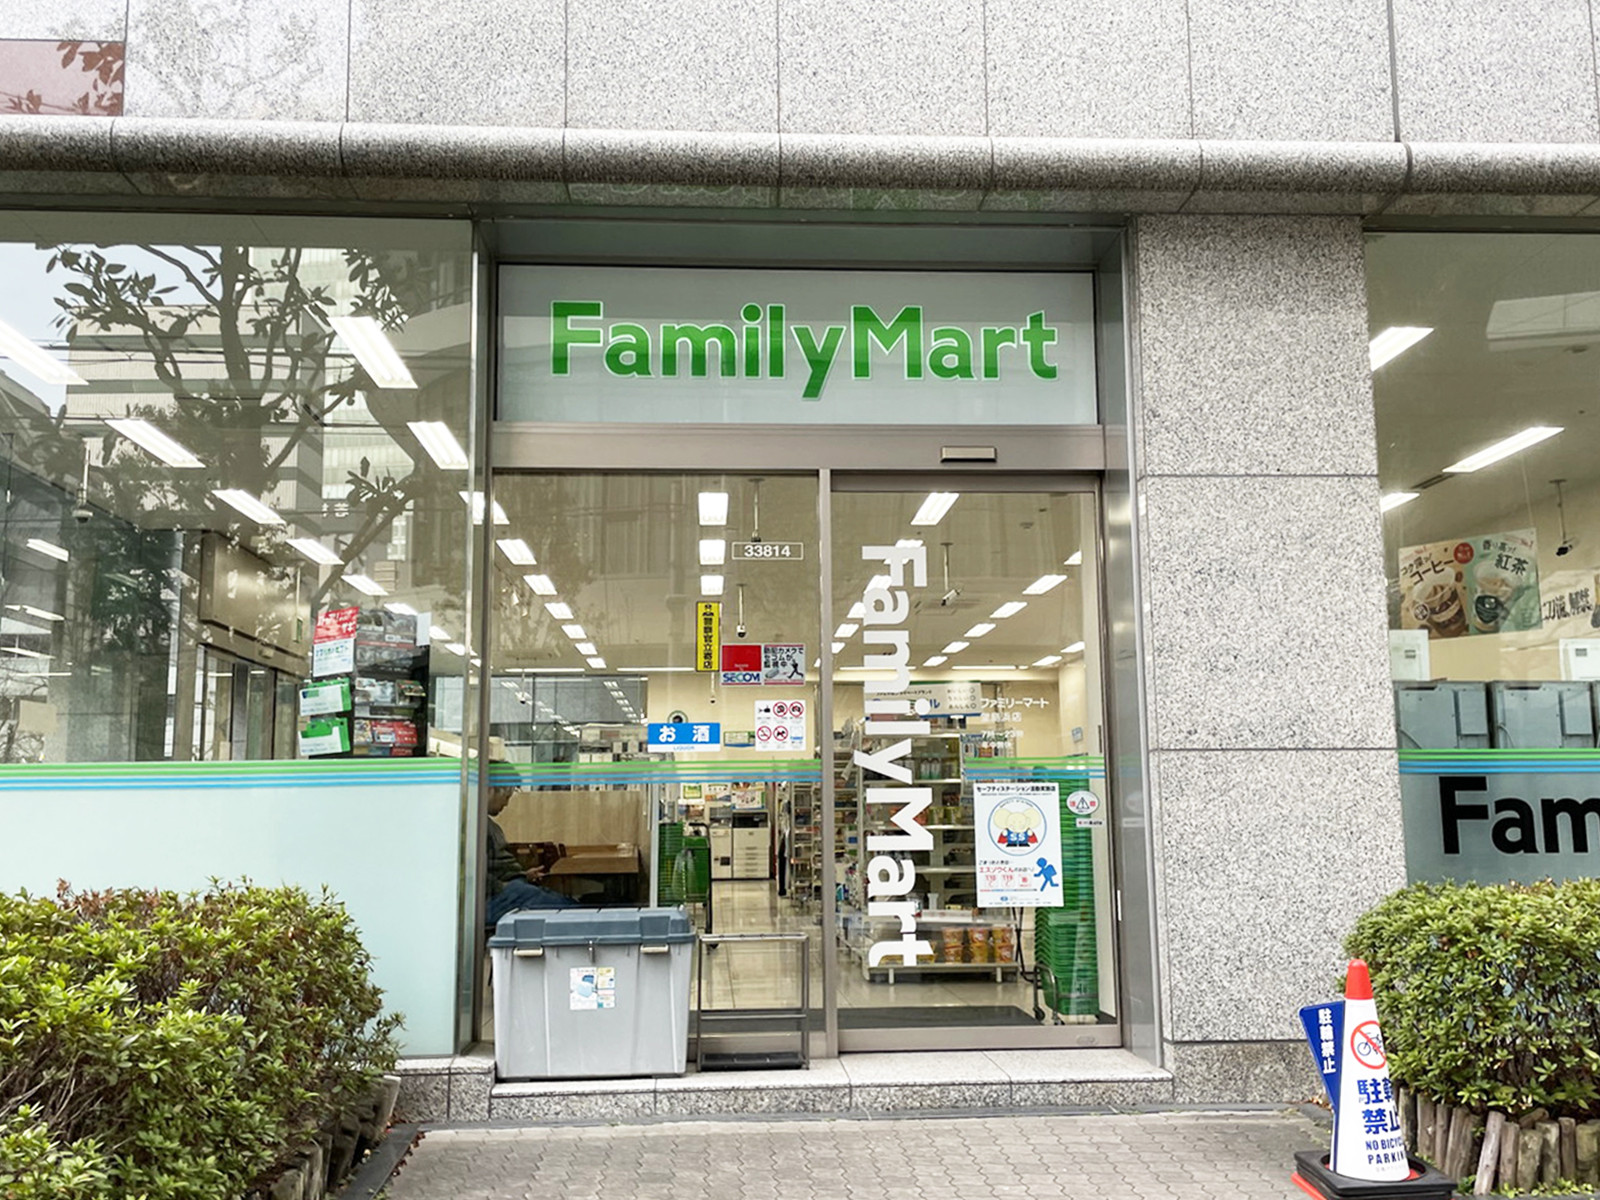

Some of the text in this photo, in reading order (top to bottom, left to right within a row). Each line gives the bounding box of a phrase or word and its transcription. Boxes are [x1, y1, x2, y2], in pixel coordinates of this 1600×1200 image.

[550, 301, 1059, 401] FamilyMart
[744, 544, 791, 557] 33814
[1409, 559, 1455, 585] コーヒー
[1494, 553, 1530, 576] 紅茶
[722, 672, 761, 682] SECOM
[980, 697, 1049, 709] ファミリーマート
[658, 725, 711, 742] お酒
[853, 545, 935, 967] FamilyMart
[1318, 1007, 1337, 1075] 駐輪禁止
[1365, 1139, 1379, 1151] NO
